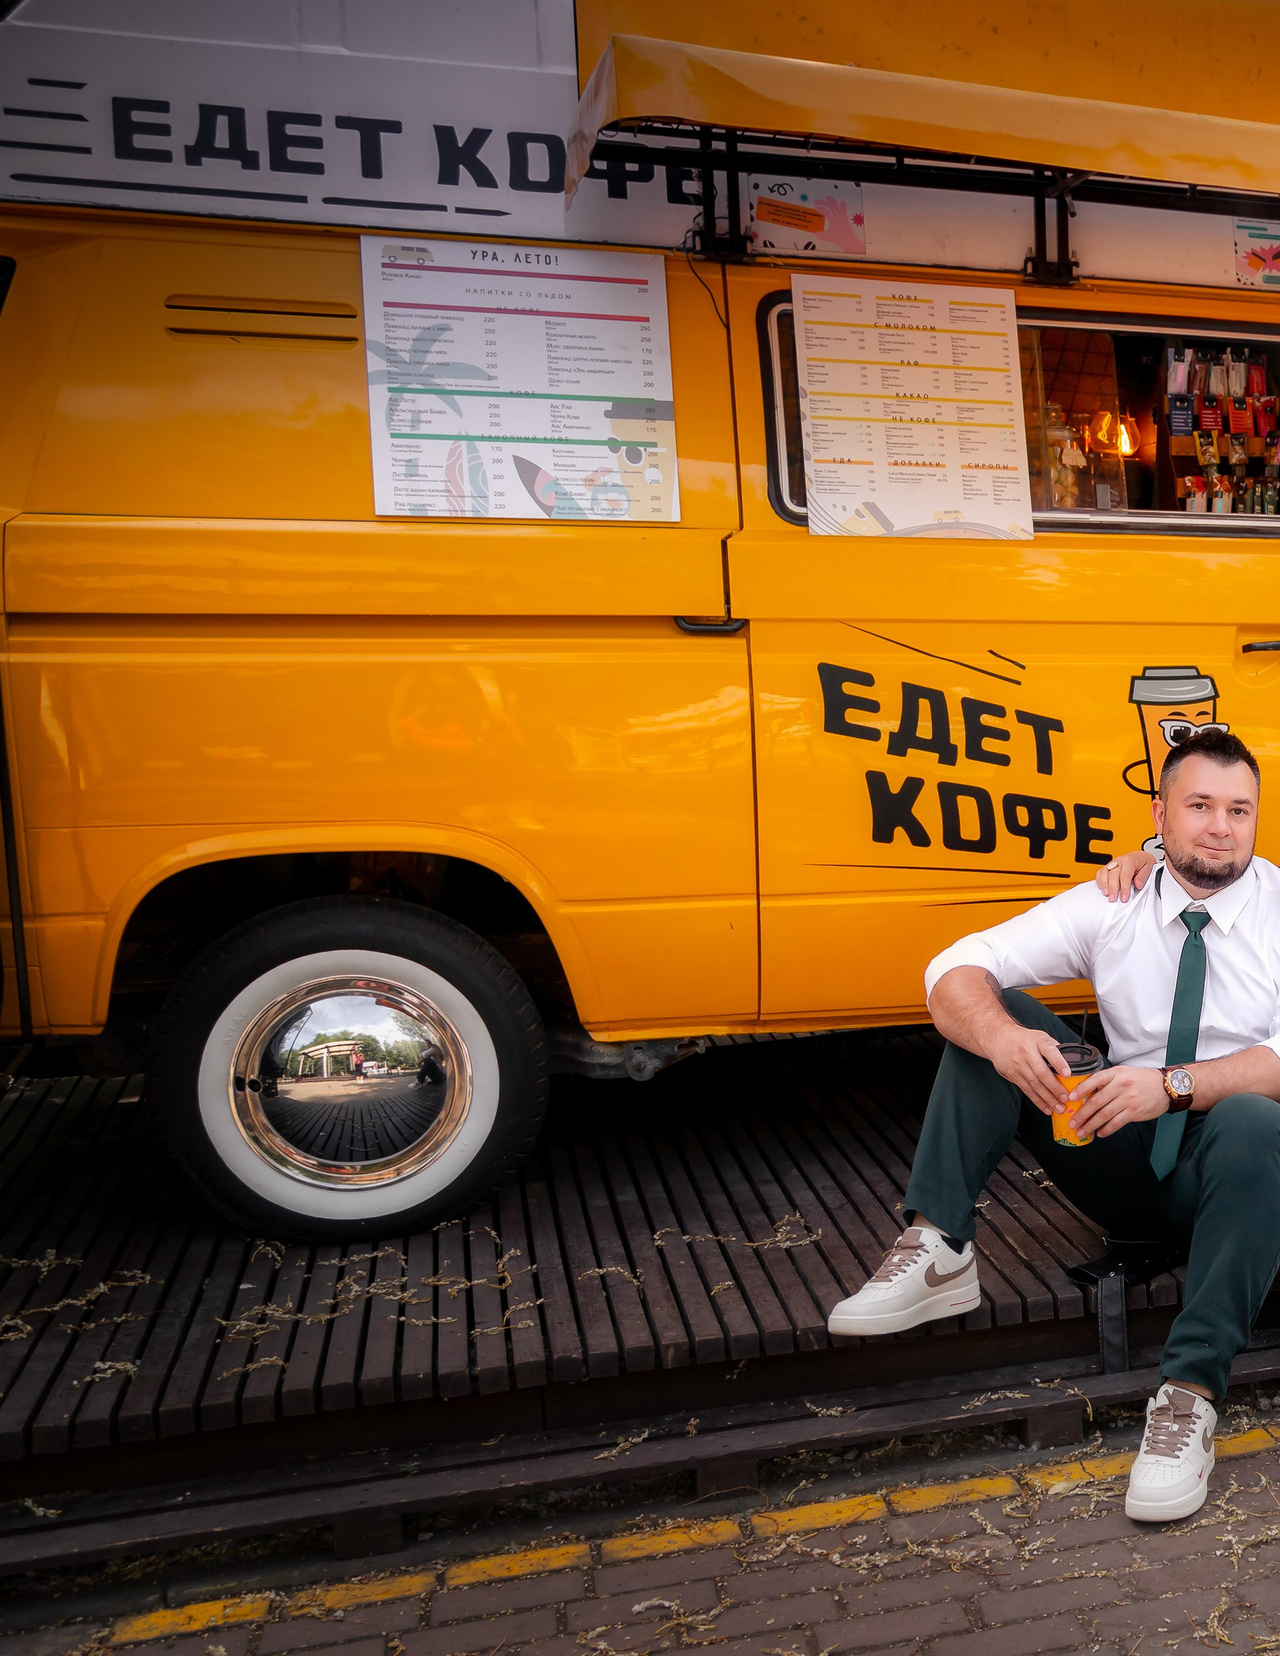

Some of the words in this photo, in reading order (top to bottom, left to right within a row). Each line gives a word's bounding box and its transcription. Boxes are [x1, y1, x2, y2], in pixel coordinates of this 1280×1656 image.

[111, 95, 403, 180] ЕДЕТ
[470, 249, 505, 263] УРА,
[514, 252, 559, 266] ЛЕТО!
[465, 288, 513, 297] НАПИТКИ
[537, 292, 572, 300] ЛЬДОМ
[885, 322, 936, 331] МОЛОКОМ
[893, 459, 941, 467] ДОБАВКИ
[817, 661, 1065, 777] ЕДЕТ
[864, 769, 1114, 865] КОФЕ
